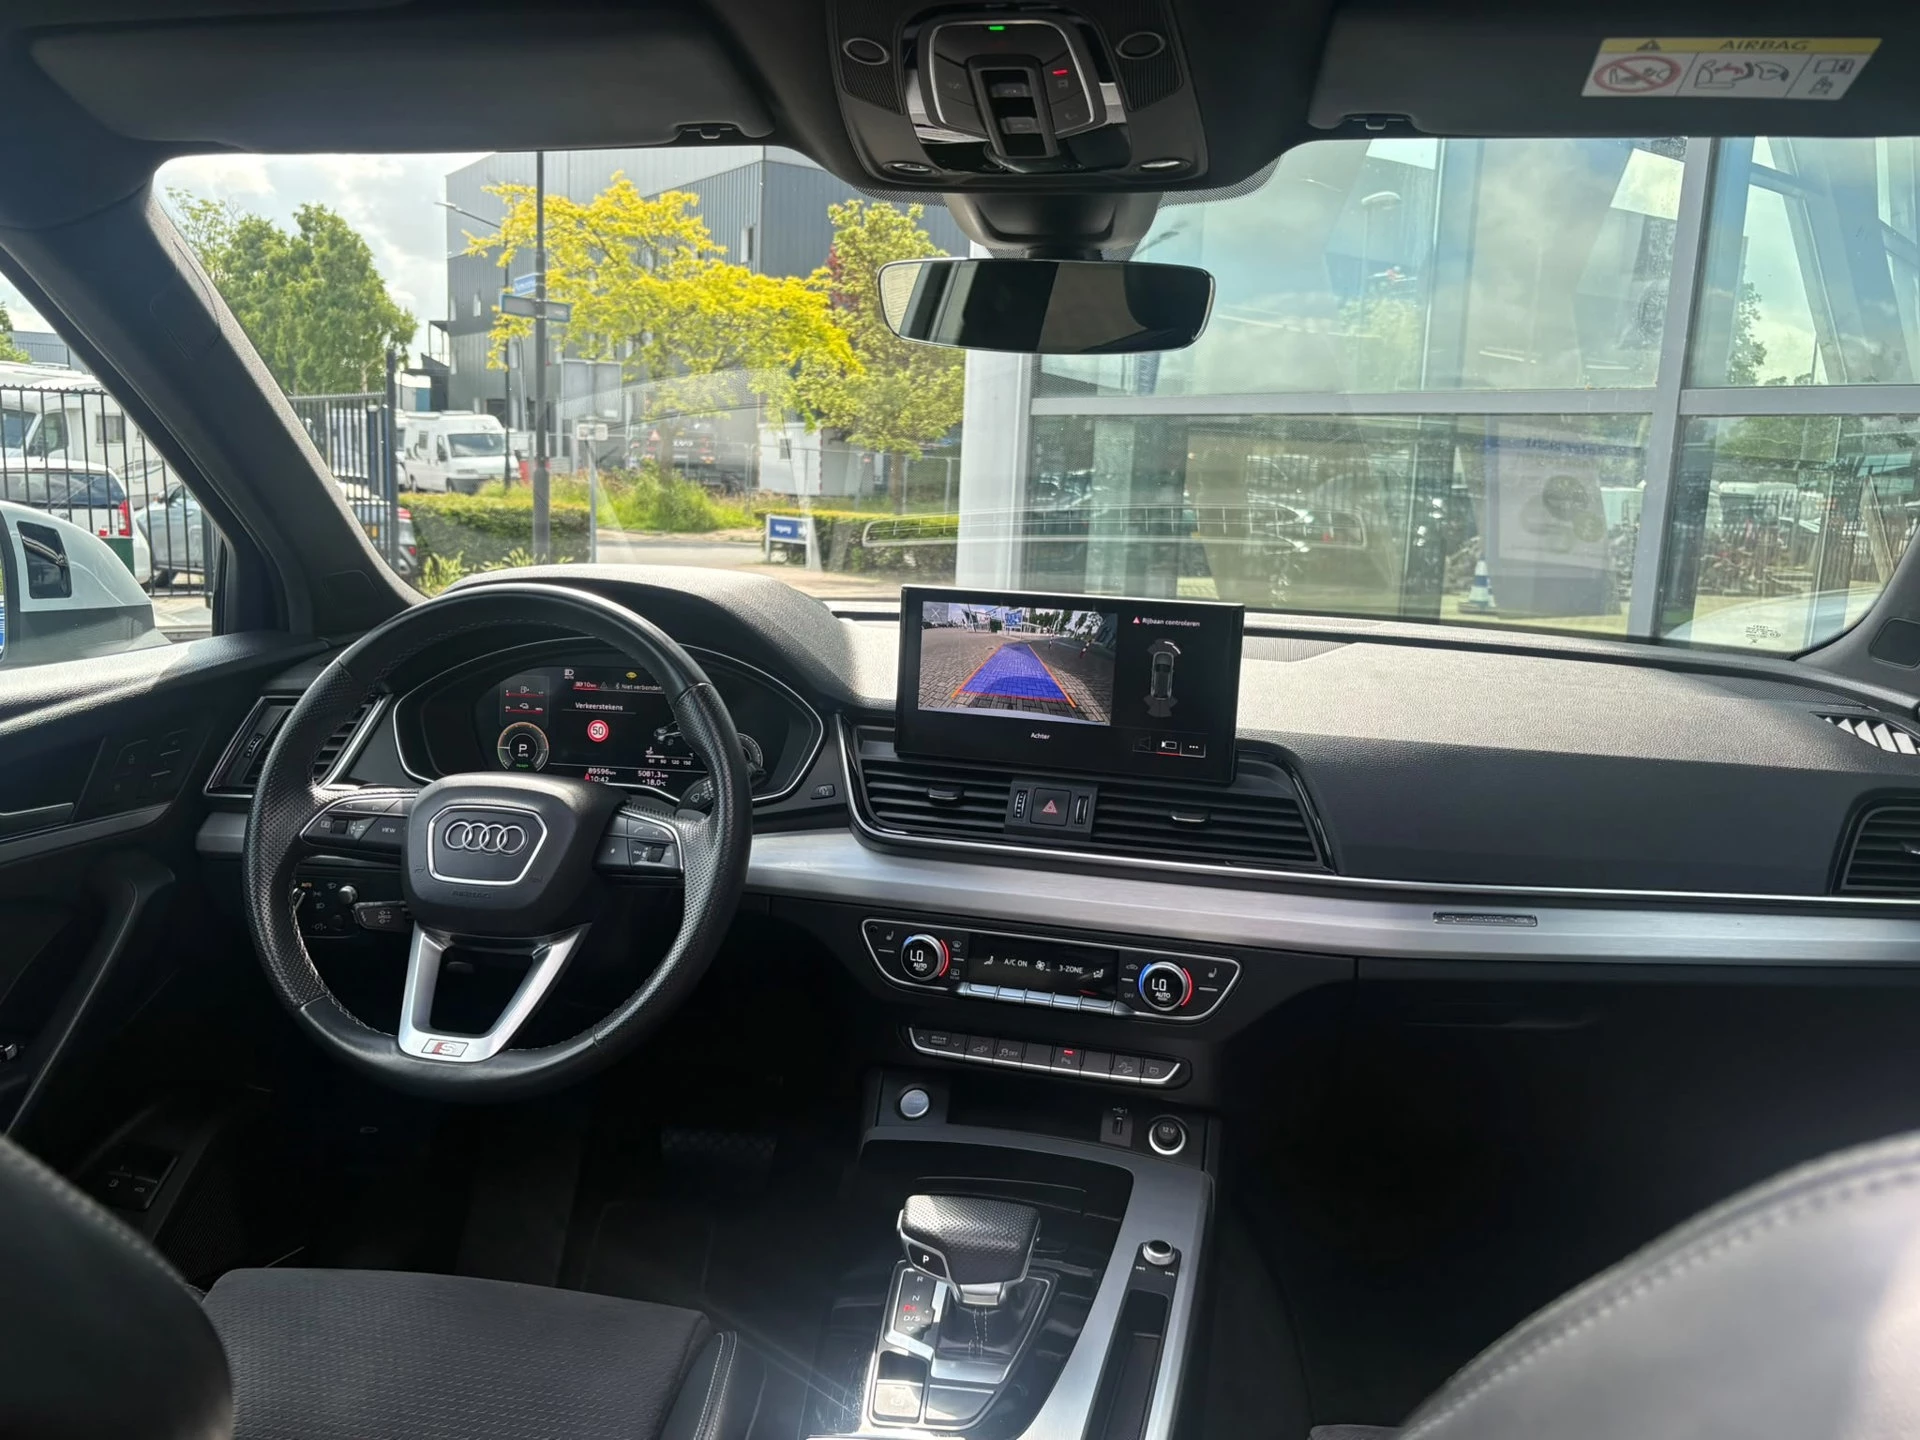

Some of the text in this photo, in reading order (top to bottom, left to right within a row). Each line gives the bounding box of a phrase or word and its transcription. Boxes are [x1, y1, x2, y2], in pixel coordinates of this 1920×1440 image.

[1720, 40, 1809, 50] AIRBAG
[1142, 617, 1201, 627] Rijbaan controleren
[575, 701, 624, 711] Verkeerstekens
[592, 725, 604, 736] 50
[1030, 732, 1050, 740] Achter
[518, 744, 528, 753] P
[1004, 958, 1028, 968] A/C ON
[1059, 964, 1083, 974] 3-ZONE
[1155, 991, 1171, 999] AUTO
[922, 1255, 930, 1263] P
